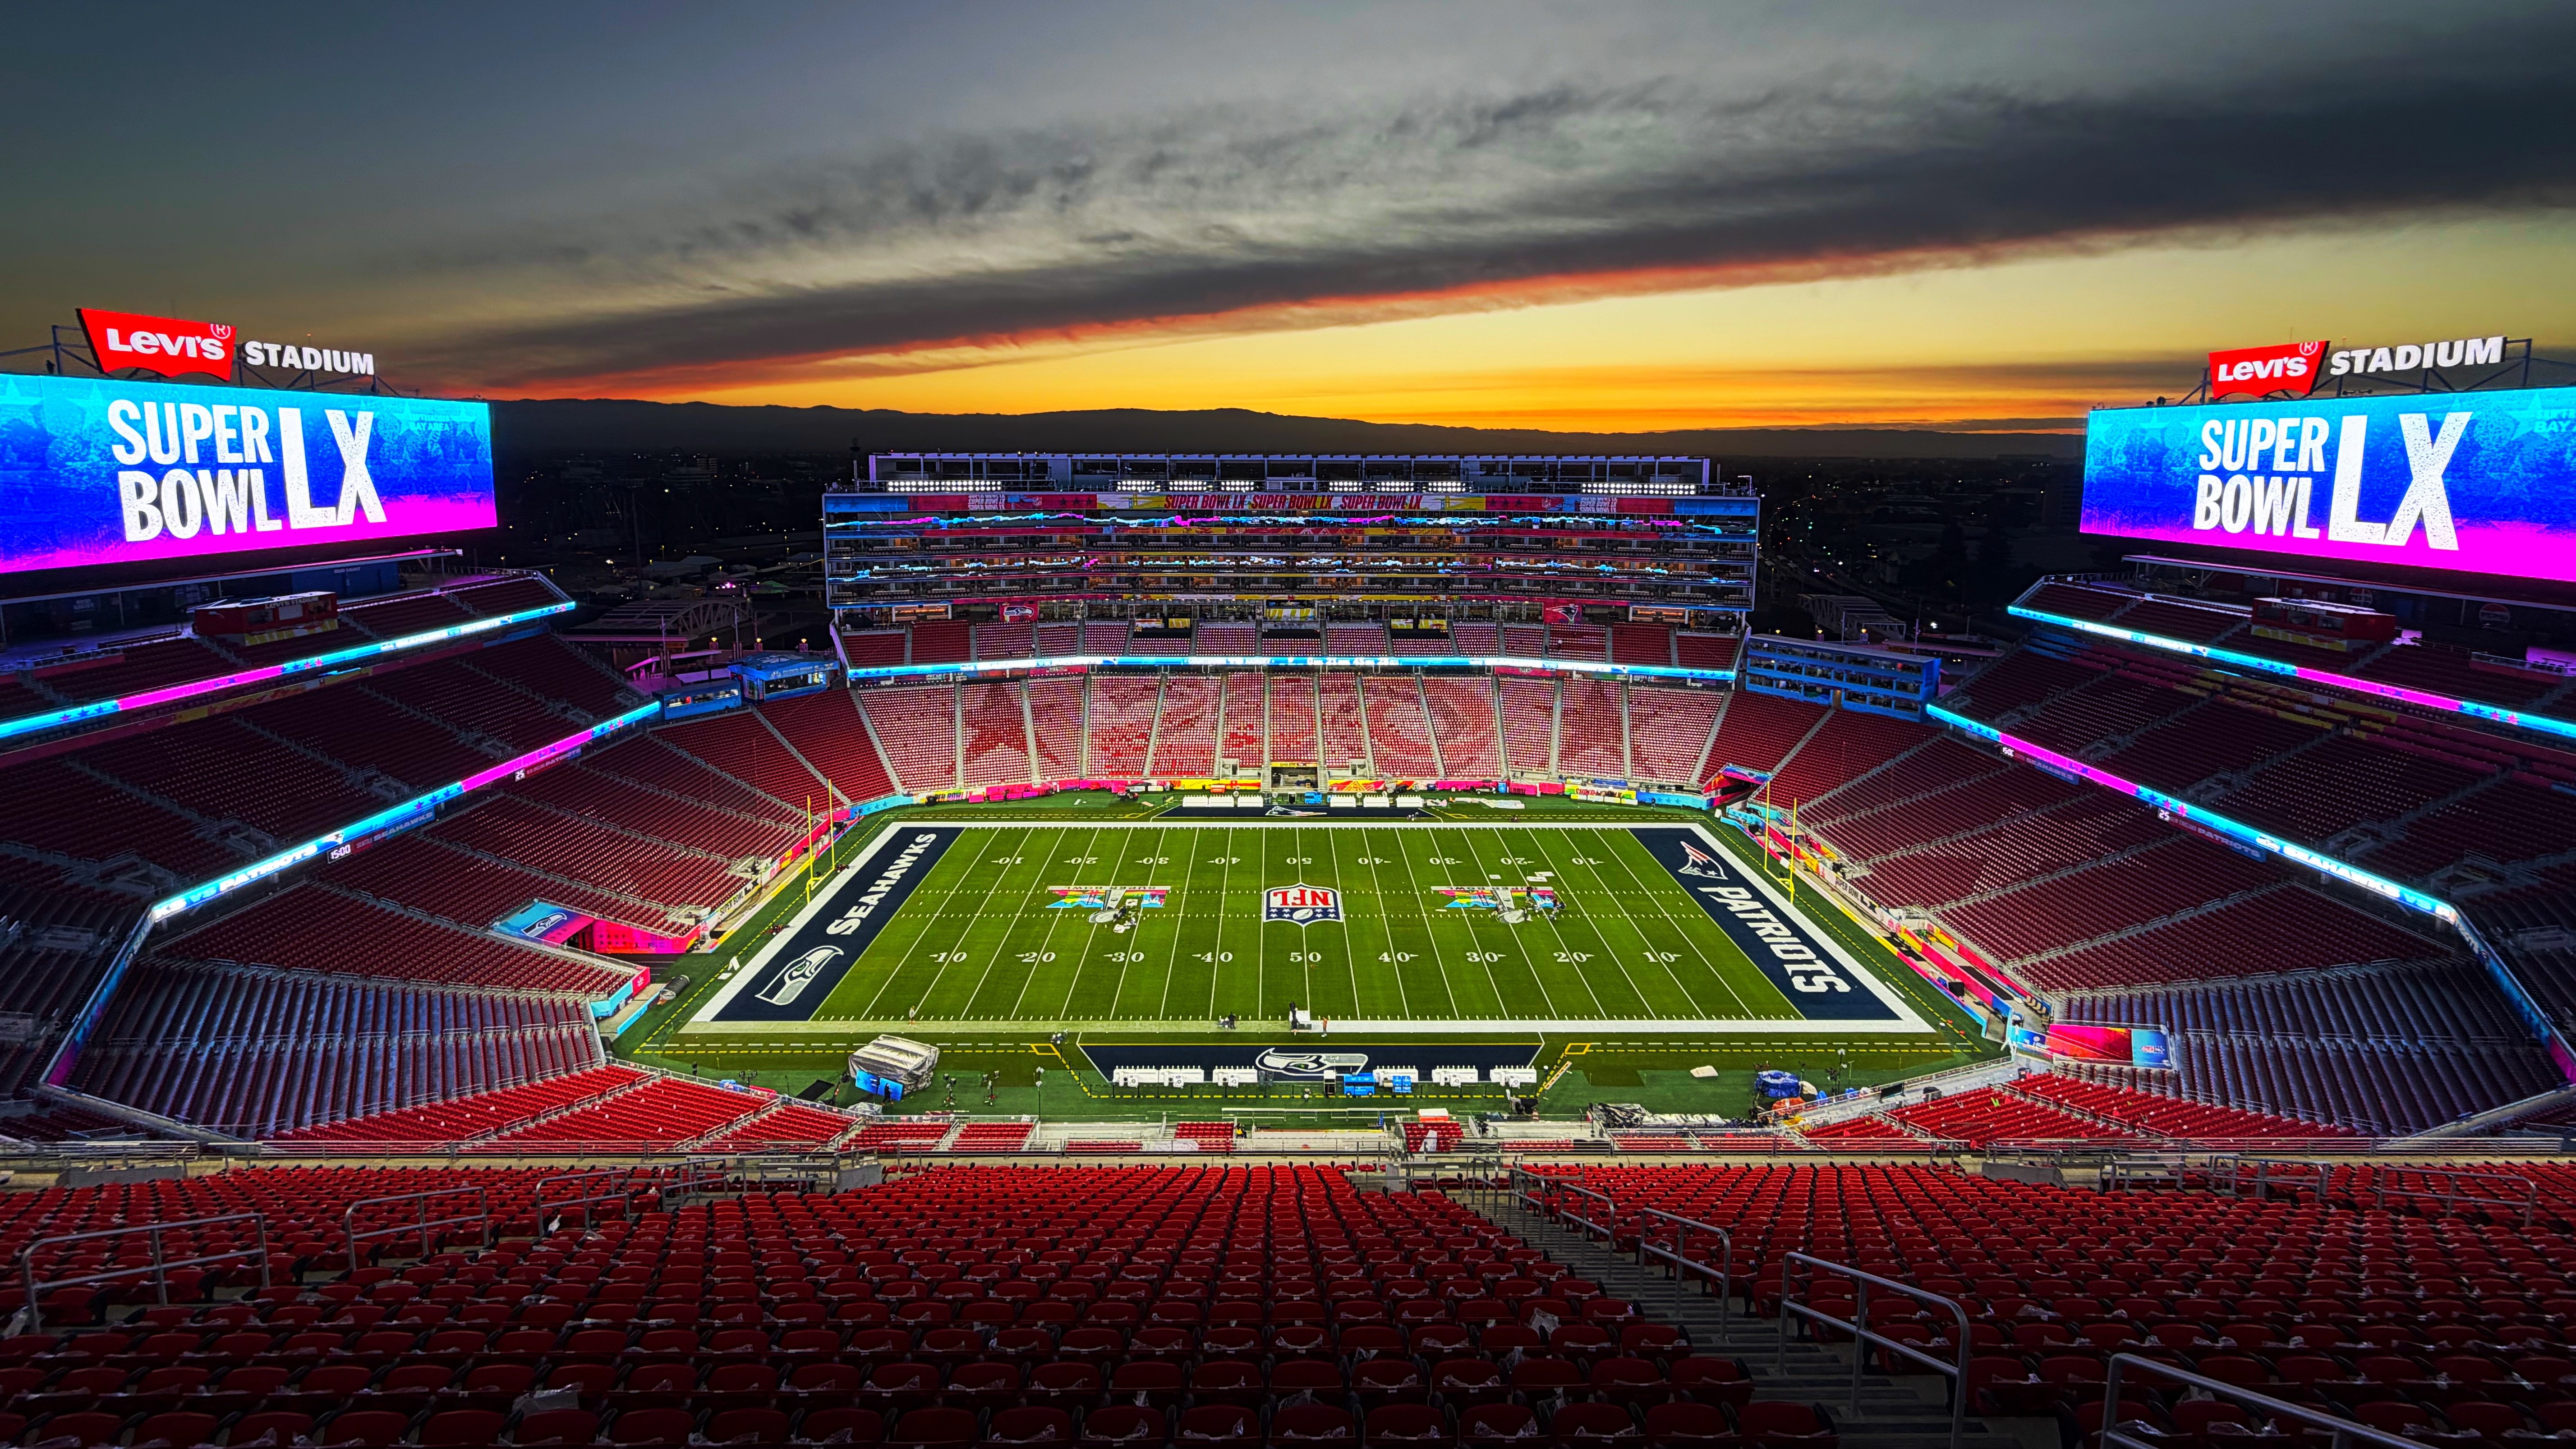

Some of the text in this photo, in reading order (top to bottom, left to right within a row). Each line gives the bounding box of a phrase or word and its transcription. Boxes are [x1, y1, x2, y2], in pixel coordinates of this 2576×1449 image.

[245, 341, 374, 375] STADIUM
[2330, 336, 2505, 376] STADIUM
[107, 400, 273, 465] SUPER
[2199, 417, 2329, 472] SUPER
[278, 408, 387, 529] LX
[2328, 411, 2474, 551] LX
[118, 469, 282, 542] BOWL
[1164, 495, 1247, 509] SUPER BOWL LX
[1251, 495, 1334, 509] SUPER BOWL LX
[1340, 495, 1424, 510] SUPER BOWL LX
[2194, 474, 2320, 539] BOWL
[515, 770, 525, 781] 25
[2159, 810, 2170, 820] 25
[373, 812, 433, 842] SEAHAWKS
[2197, 828, 2261, 857] PATRIOTS
[330, 844, 351, 860] 15:00
[219, 844, 317, 892] PATRIOTS
[2283, 845, 2400, 898] SEAHAWKS
[826, 833, 938, 936] SEAHAWKS
[1273, 889, 1331, 906] NFL
[1848, 886, 1860, 901] BOWL
[1696, 887, 1852, 992] PATRIOTS
[934, 952, 967, 962] 10
[1022, 952, 1056, 962] 20
[1110, 952, 1145, 962] 30
[1199, 952, 1233, 962] 40
[1289, 952, 1322, 962] 50
[1378, 952, 1410, 962] 40
[1466, 952, 1498, 962] 30
[1553, 952, 1587, 962] 20
[1642, 952, 1676, 962] 10
